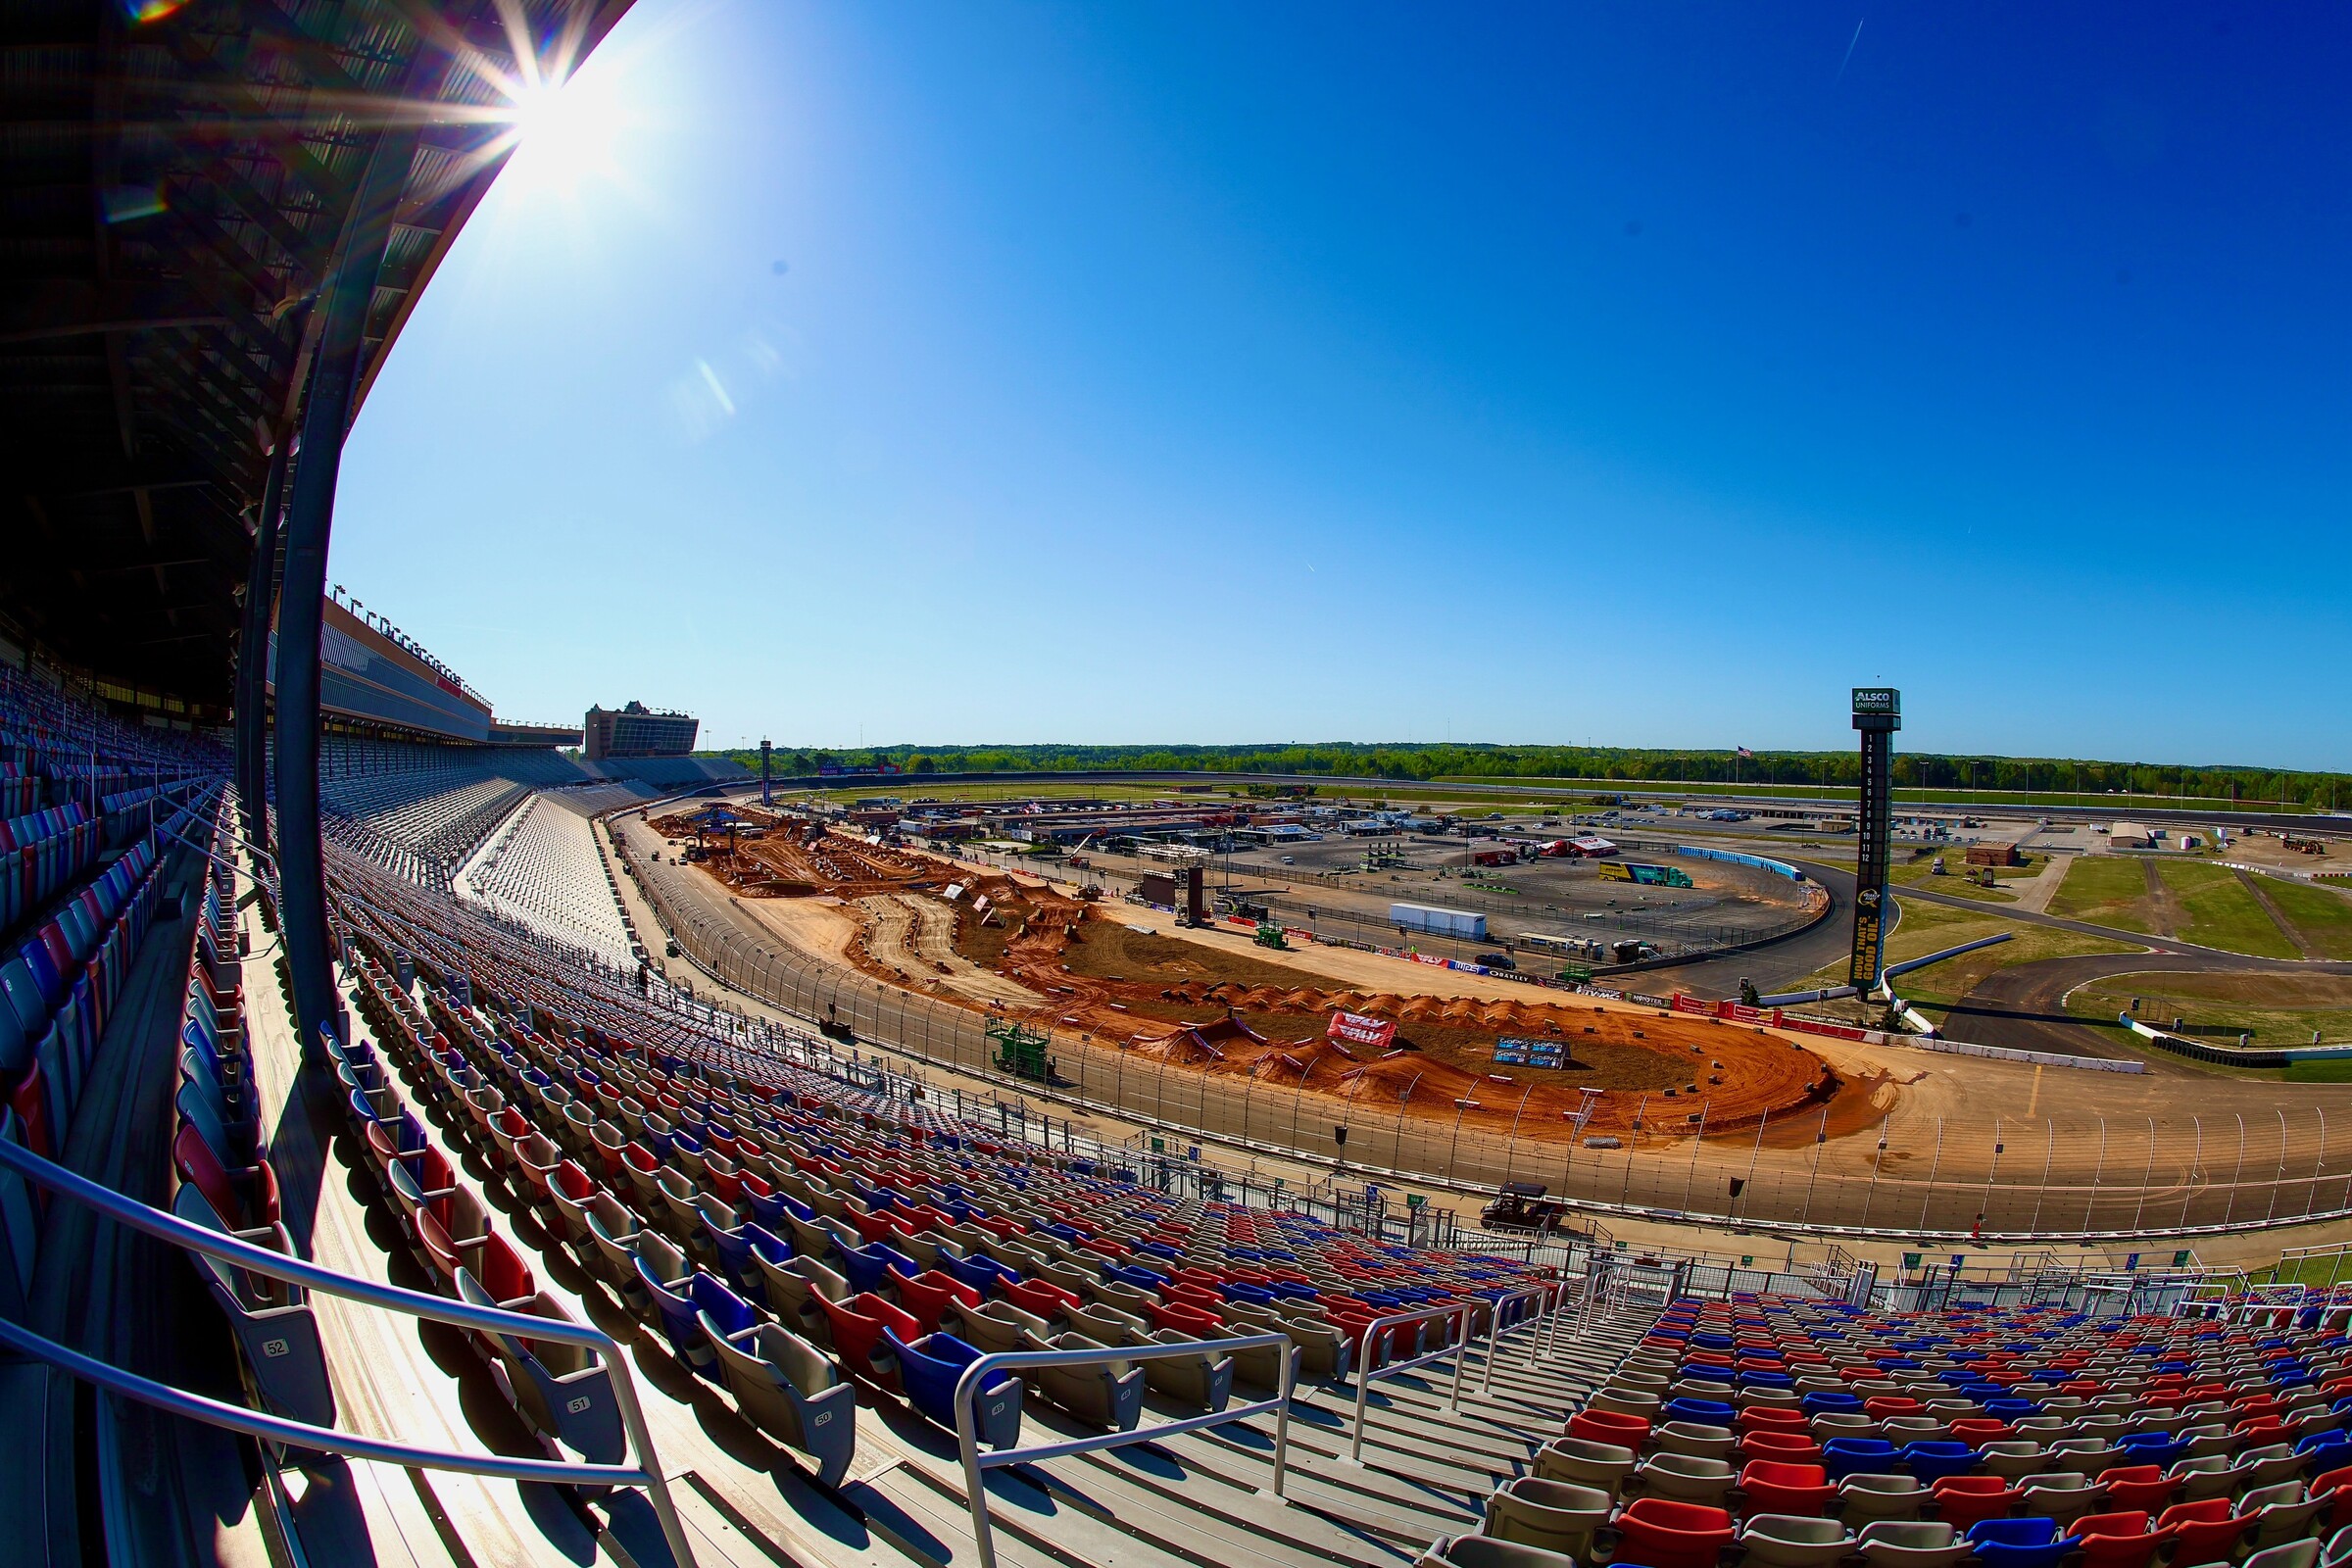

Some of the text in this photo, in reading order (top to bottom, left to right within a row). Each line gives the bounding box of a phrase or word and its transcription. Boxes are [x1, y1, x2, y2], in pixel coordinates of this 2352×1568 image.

[1855, 691, 1890, 701] ALSCO
[1854, 916, 1867, 980] NOW THAT'S
[1455, 961, 1479, 974] WPS
[1863, 946, 1876, 980] GOOD
[1633, 995, 1662, 1005] MONSTER
[1342, 1013, 1388, 1028] FLY
[1337, 1024, 1384, 1040] FLY
[268, 1341, 284, 1355] 52
[572, 1399, 587, 1411] 51
[993, 1403, 1004, 1414] 49
[817, 1413, 830, 1424] 50
